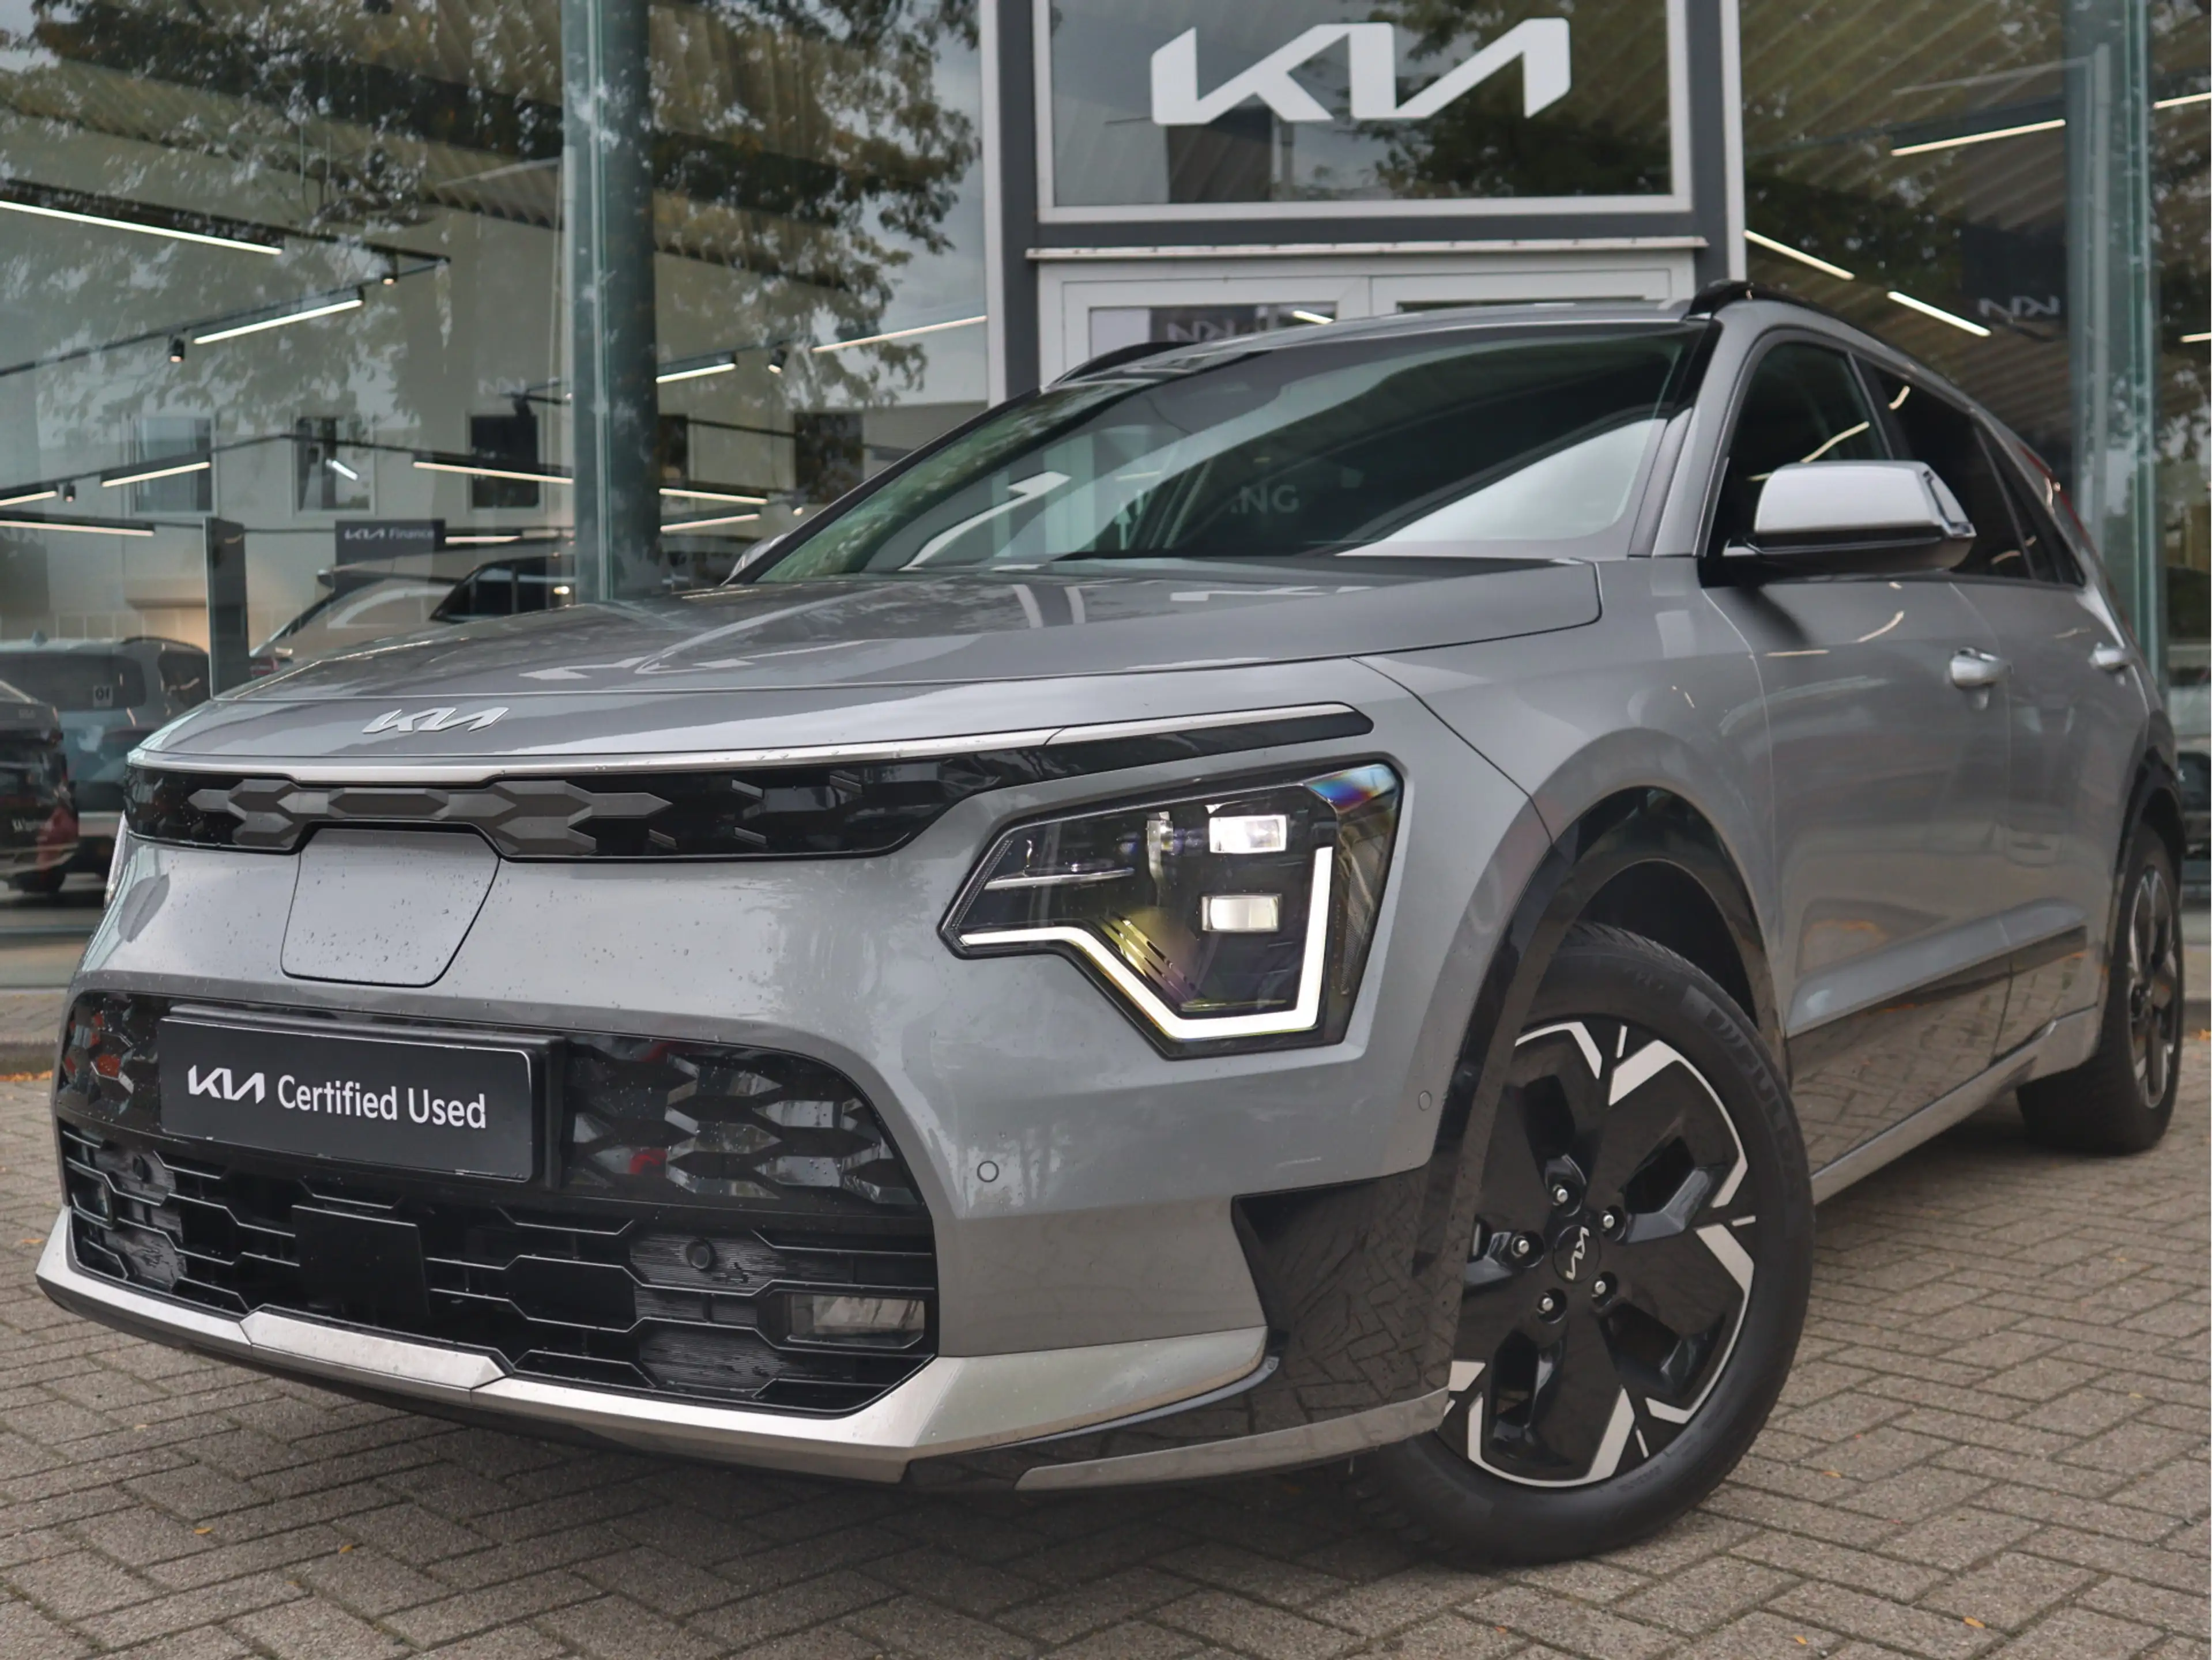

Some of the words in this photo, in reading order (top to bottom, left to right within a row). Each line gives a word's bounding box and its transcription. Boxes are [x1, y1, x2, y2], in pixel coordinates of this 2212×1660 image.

[1151, 17, 1572, 125] KIA
[361, 707, 510, 734] KIA
[188, 1065, 265, 1104] KIA
[277, 1074, 398, 1120] Certified
[408, 1087, 487, 1129] Used
